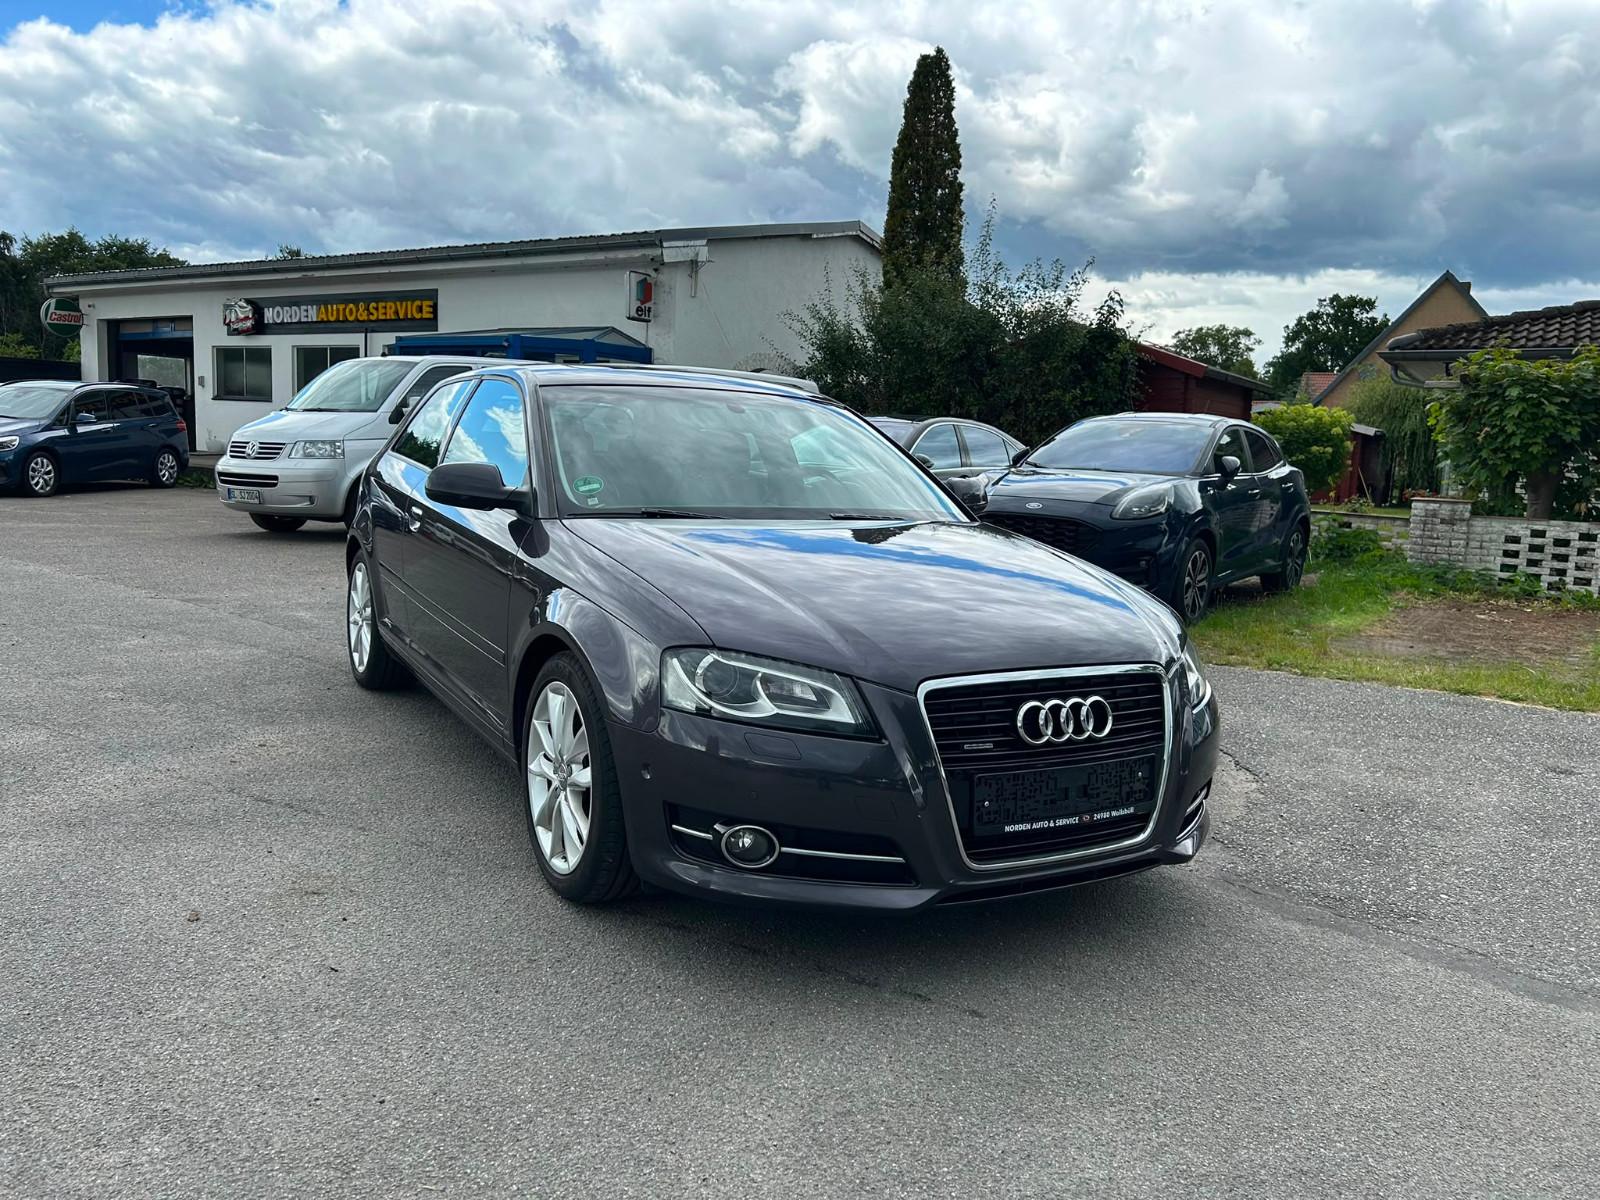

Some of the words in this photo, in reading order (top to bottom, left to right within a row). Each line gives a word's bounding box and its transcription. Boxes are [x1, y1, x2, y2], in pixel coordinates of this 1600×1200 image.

[50, 312, 81, 324] Castrol
[635, 305, 653, 319] elf
[1005, 823, 1031, 833] NORDEN
[1032, 820, 1049, 829] AUTO
[1049, 819, 1055, 827] &
[1055, 816, 1080, 826] SERVICE
